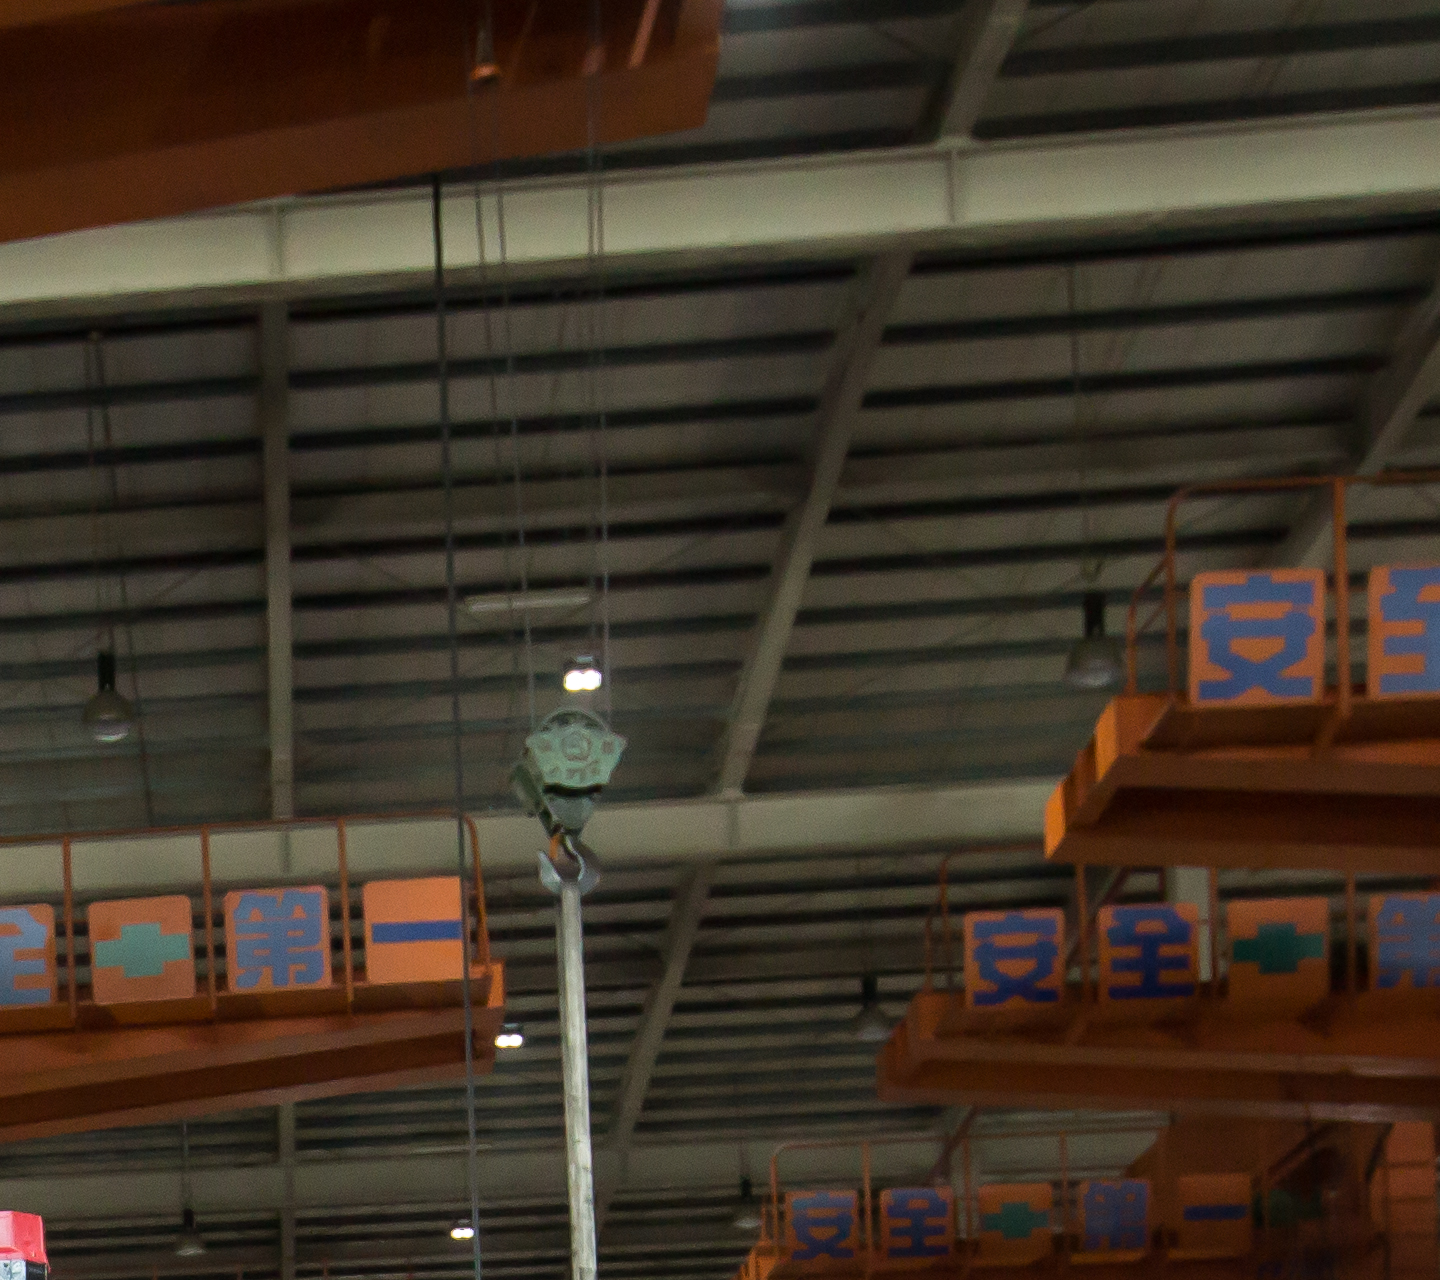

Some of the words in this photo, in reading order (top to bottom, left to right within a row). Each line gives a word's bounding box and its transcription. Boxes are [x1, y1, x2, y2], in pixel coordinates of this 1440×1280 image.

[232, 890, 463, 990] 第一
[970, 906, 1197, 1007] 安全
[791, 1188, 950, 1261] 安全
